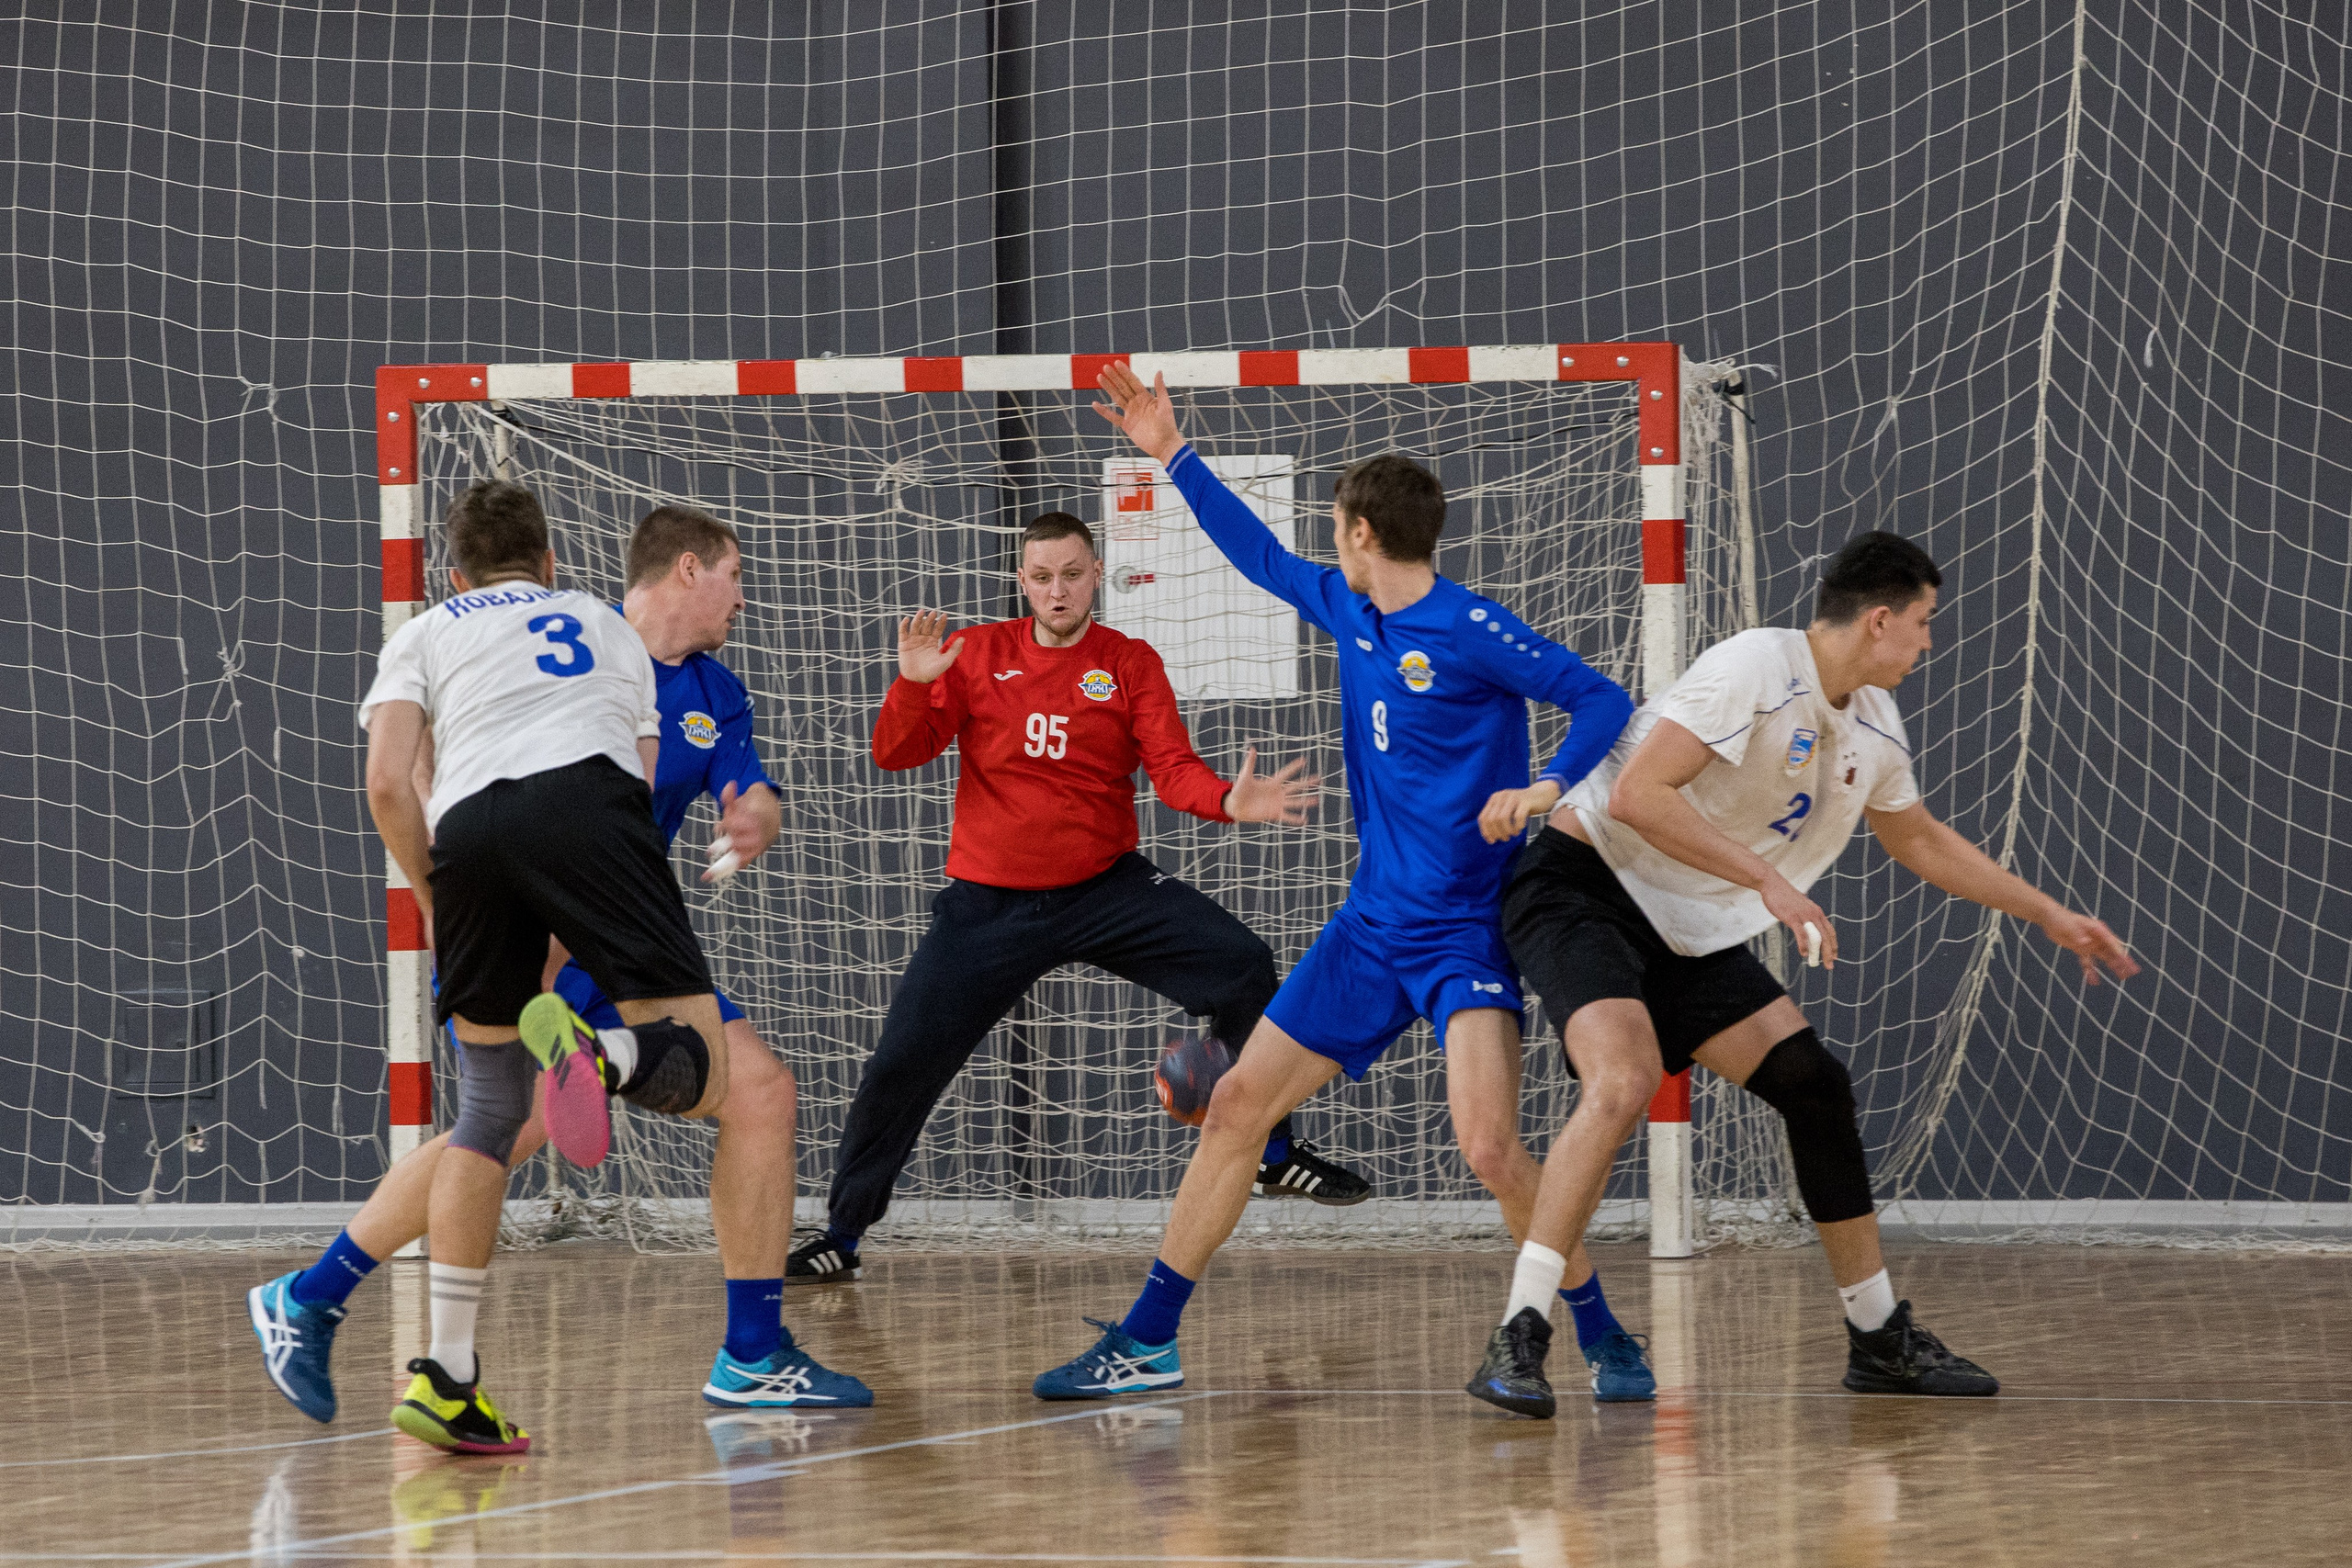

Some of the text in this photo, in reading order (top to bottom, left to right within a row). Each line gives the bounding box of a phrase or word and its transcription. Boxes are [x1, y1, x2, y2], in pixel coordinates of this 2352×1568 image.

[527, 613, 595, 677] 3
[1024, 712, 1069, 760] 95
[1372, 700, 1389, 751] 9
[1768, 792, 1812, 842] 2
